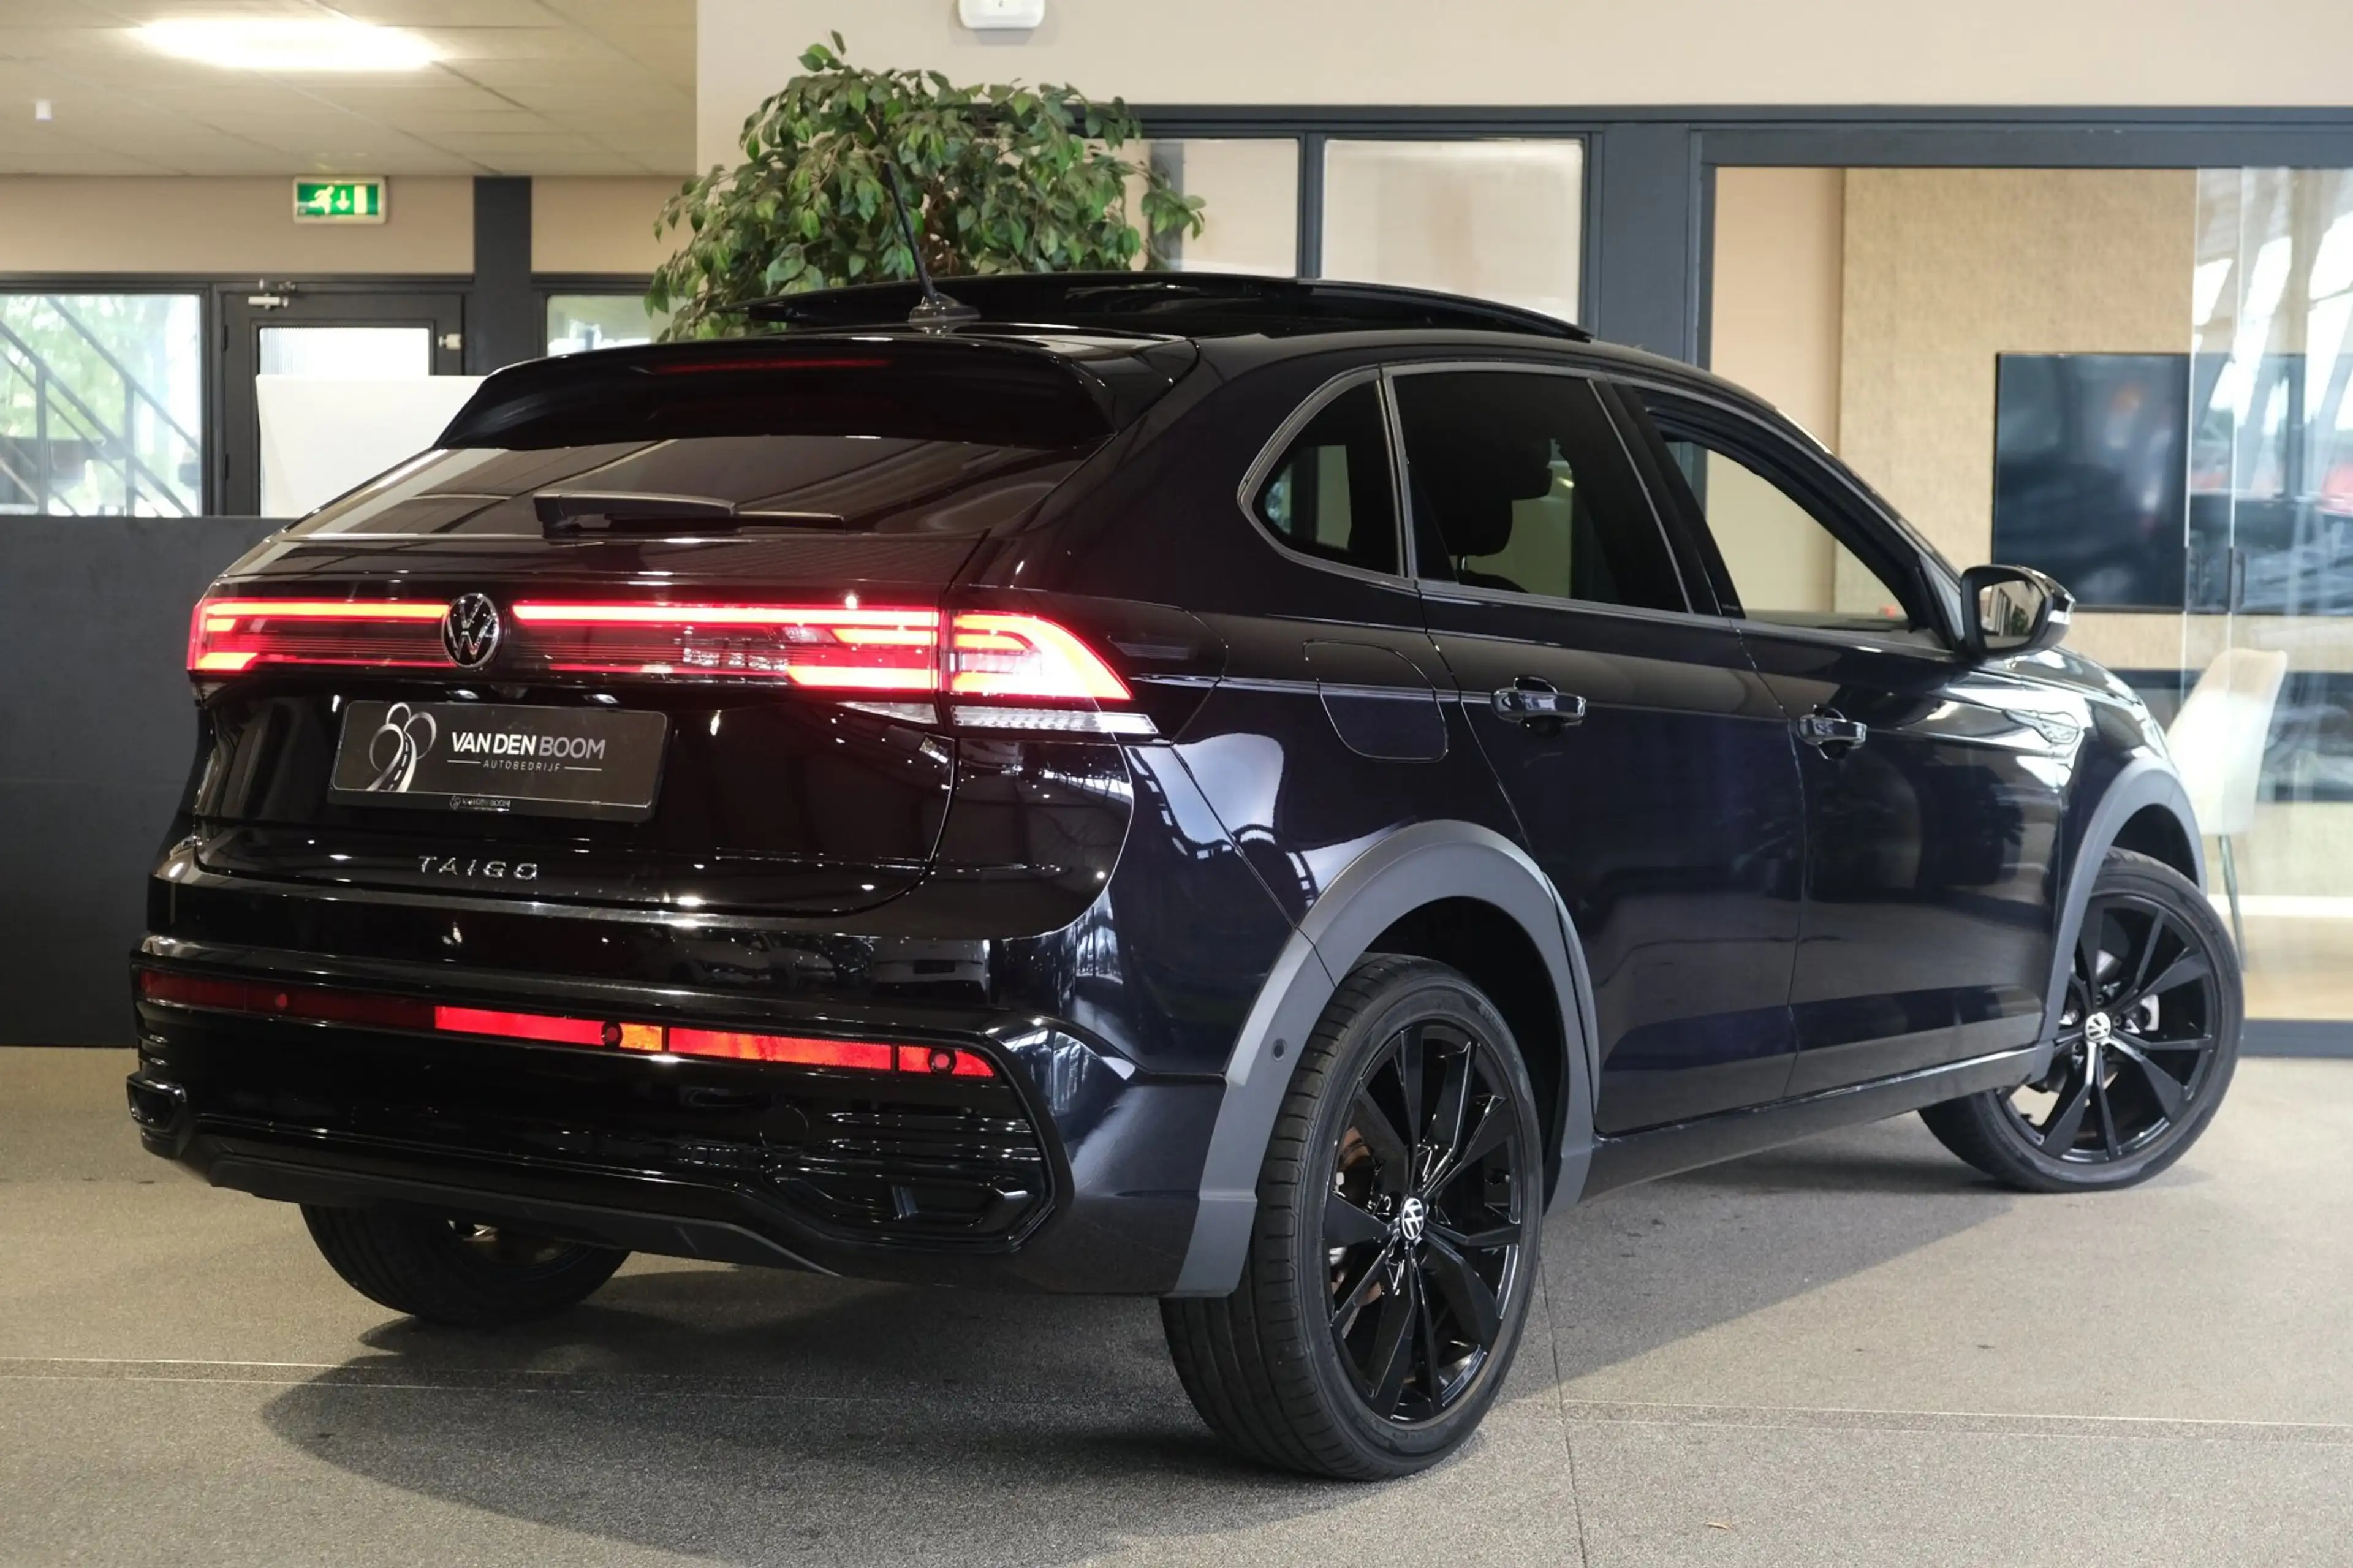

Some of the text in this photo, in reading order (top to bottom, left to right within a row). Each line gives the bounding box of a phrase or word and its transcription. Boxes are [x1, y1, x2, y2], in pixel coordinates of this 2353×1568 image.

[452, 732, 606, 760] VAN DEN BOOM
[483, 759, 561, 772] AUTOBEDRIJF
[418, 856, 537, 880] TAIGO
